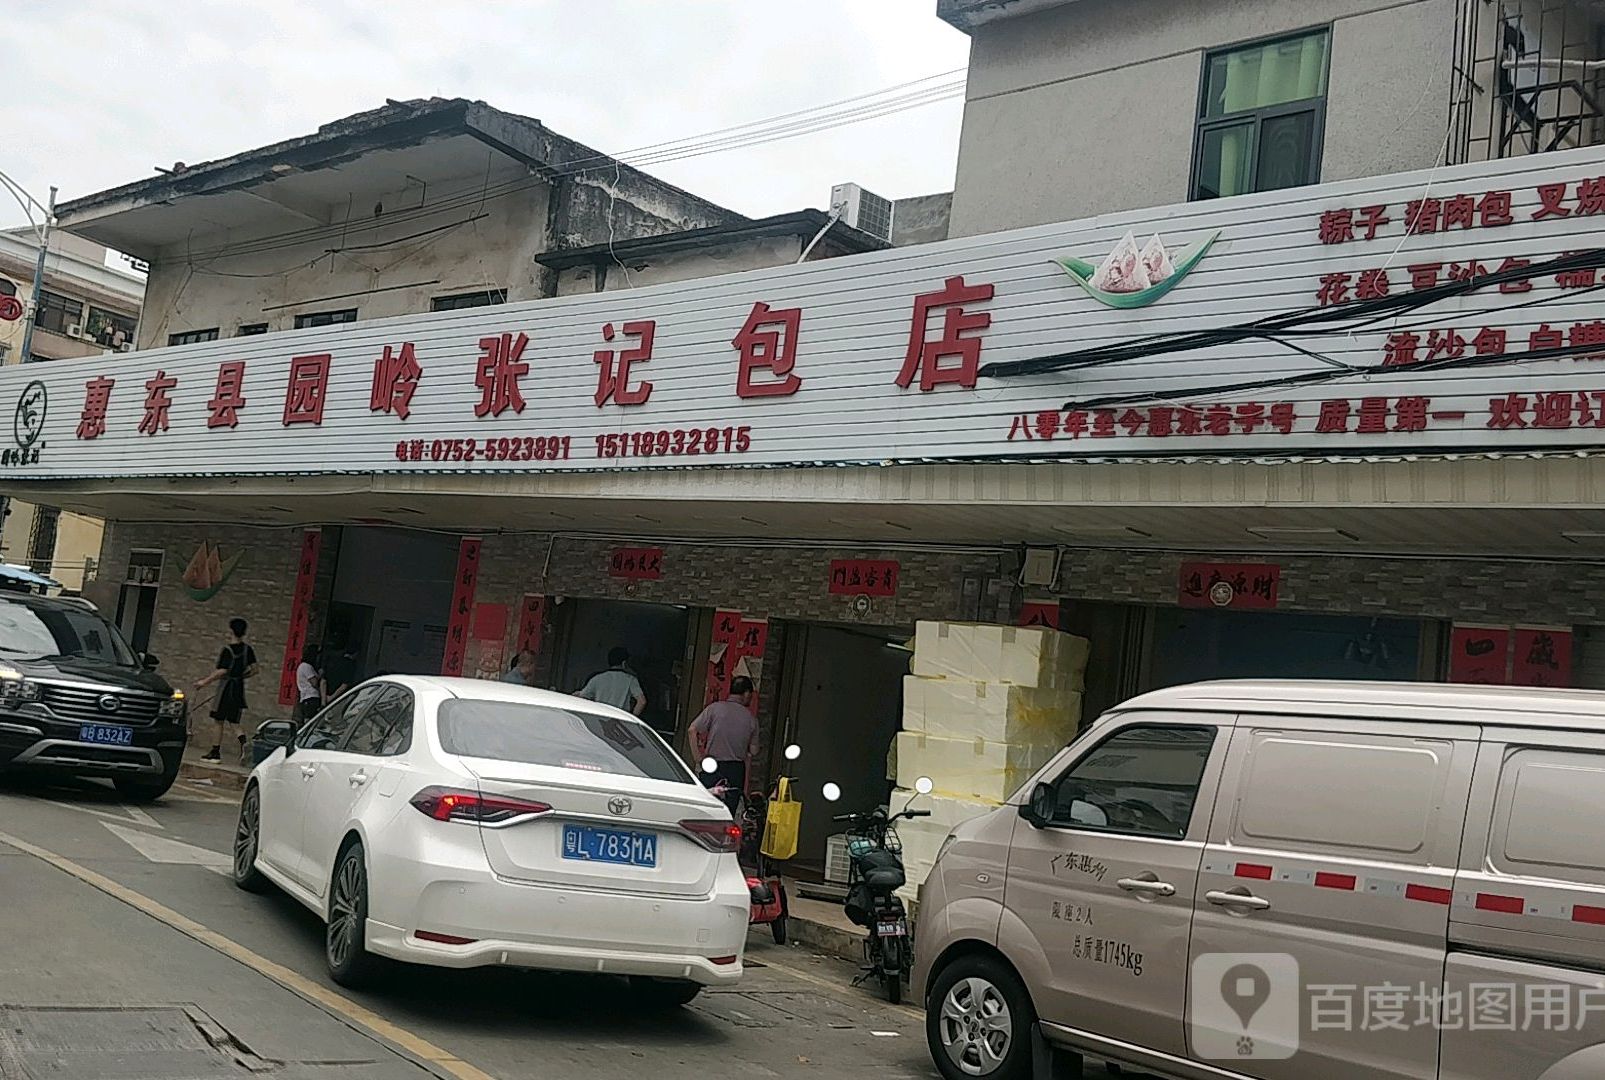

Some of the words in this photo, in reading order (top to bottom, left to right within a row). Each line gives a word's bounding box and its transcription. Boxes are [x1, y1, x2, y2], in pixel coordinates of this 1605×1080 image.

[1318, 205, 1390, 245] 粽子
[1404, 191, 1514, 236] 猪肉包
[76, 275, 995, 440] 惠东县园岭张记包店
[1007, 402, 1297, 440] 八零年至今惠东老字号
[1315, 396, 1465, 434] 质量第一
[1486, 391, 1605, 429] 欢迎订
[595, 426, 751, 459] 15118932815
[1072, 934, 1144, 977] 总质量1745kg
